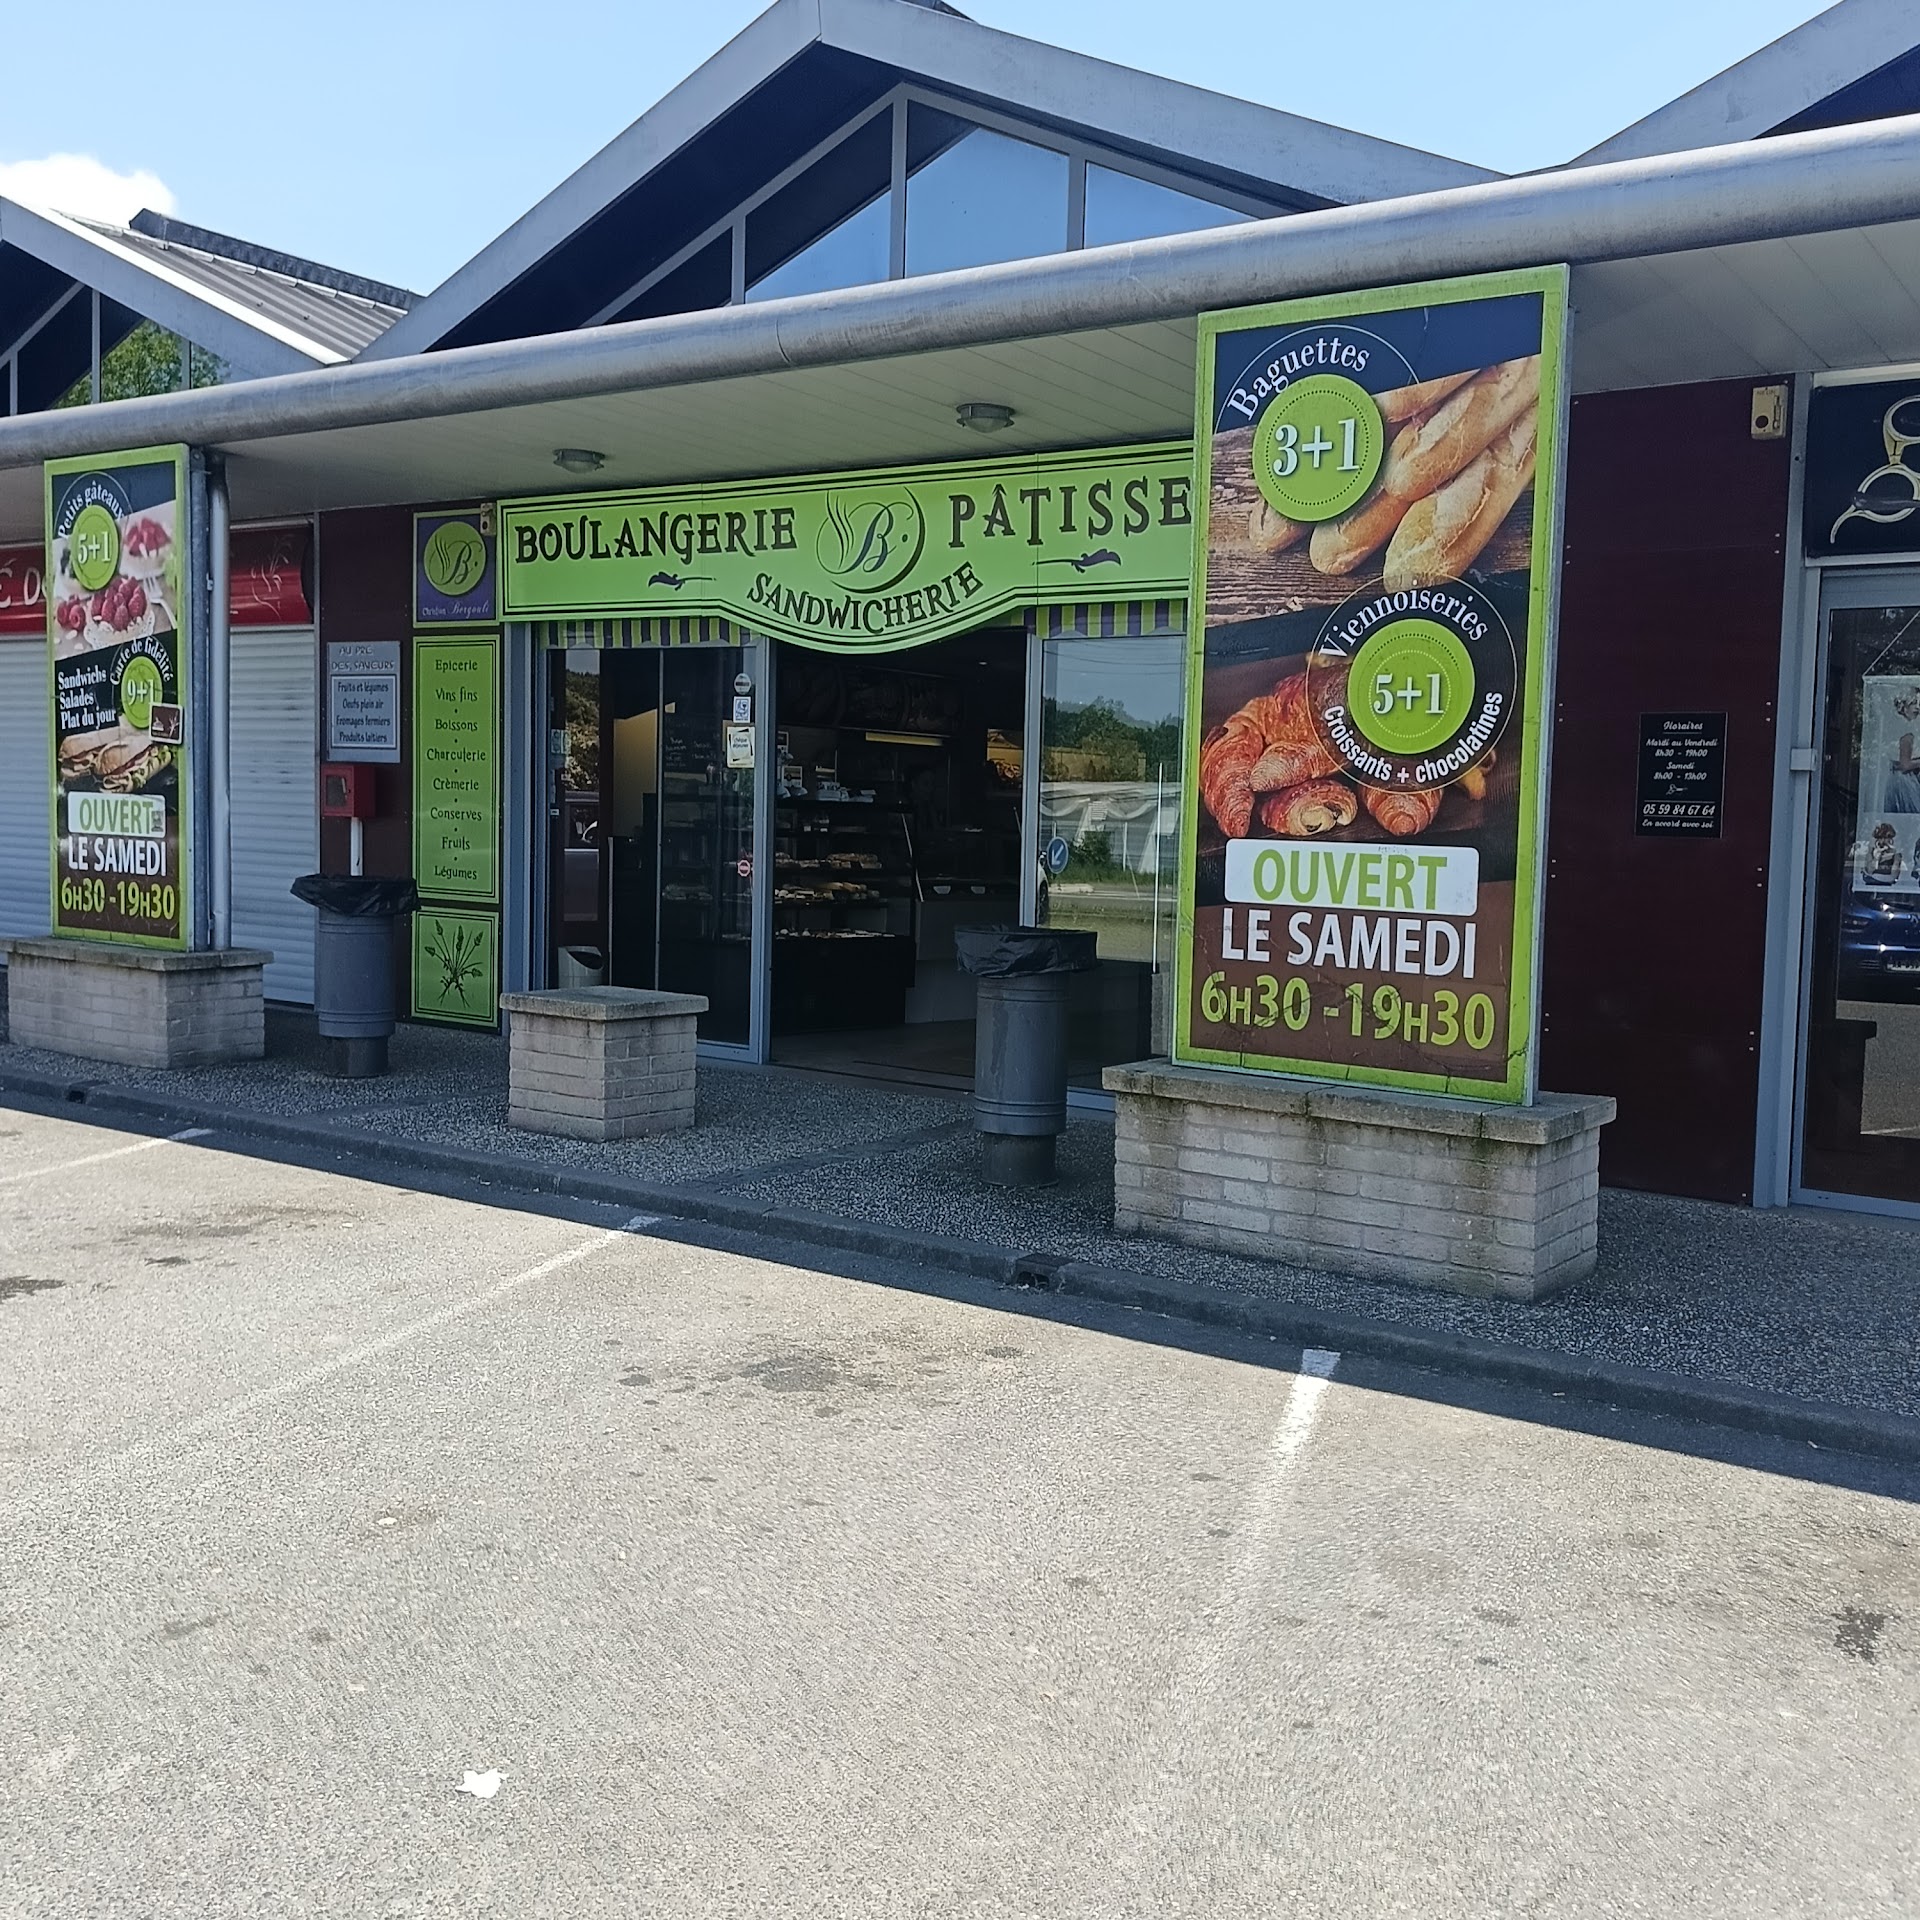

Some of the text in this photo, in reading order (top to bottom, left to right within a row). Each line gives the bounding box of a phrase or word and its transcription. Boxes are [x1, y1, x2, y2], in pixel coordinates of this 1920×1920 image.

[1226, 336, 1371, 421] Baguettes
[1272, 418, 1360, 477] 3+1
[57, 480, 125, 538] Petits gâteaux
[515, 507, 797, 565] BOULANGERIE
[77, 530, 111, 564] 5+1
[747, 561, 984, 634] SANDWICHERIE
[1318, 579, 1488, 659] Viennoiseries
[339, 646, 352, 656] AU
[109, 636, 174, 686] Carte de fidélité
[354, 661, 395, 672] SAVEURS
[435, 659, 478, 673] Epicerie
[58, 664, 107, 690] Sandwichs
[127, 679, 154, 706] 9+1
[338, 681, 389, 695] Fruits et légumes
[435, 686, 478, 703] Vins fins
[1373, 673, 1444, 714] 5+1
[59, 687, 94, 710] Salades
[360, 698, 375, 712] plein
[375, 699, 384, 709] air
[61, 705, 117, 730] Plat du jour
[336, 715, 391, 728] Fromages fermiers
[435, 718, 478, 732] Boissons
[1663, 720, 1703, 731] Horaires
[339, 731, 388, 743] Produits laitiers
[1397, 767, 1409, 783] +
[1415, 691, 1503, 784] chocolatines
[1646, 738, 1669, 747] Mardi
[1684, 738, 1718, 747] Vendredi
[426, 748, 486, 762] Charcuterie
[1685, 748, 1708, 757] 19h00
[1666, 761, 1695, 770] Samedi
[432, 777, 479, 791] Crèmerie
[79, 797, 154, 835] OUVERT
[430, 806, 482, 822] Conserves
[1643, 803, 1715, 816] 05 59 84 67 64
[1642, 819, 1653, 827] En
[1654, 819, 1680, 828] accord
[1701, 820, 1714, 829] soi
[441, 836, 471, 851] Fruits
[68, 835, 167, 876] LE SAMEDI
[434, 865, 477, 880] Légumes
[1253, 848, 1448, 911] OUVERT
[1221, 907, 1477, 979] LE SAMEDI
